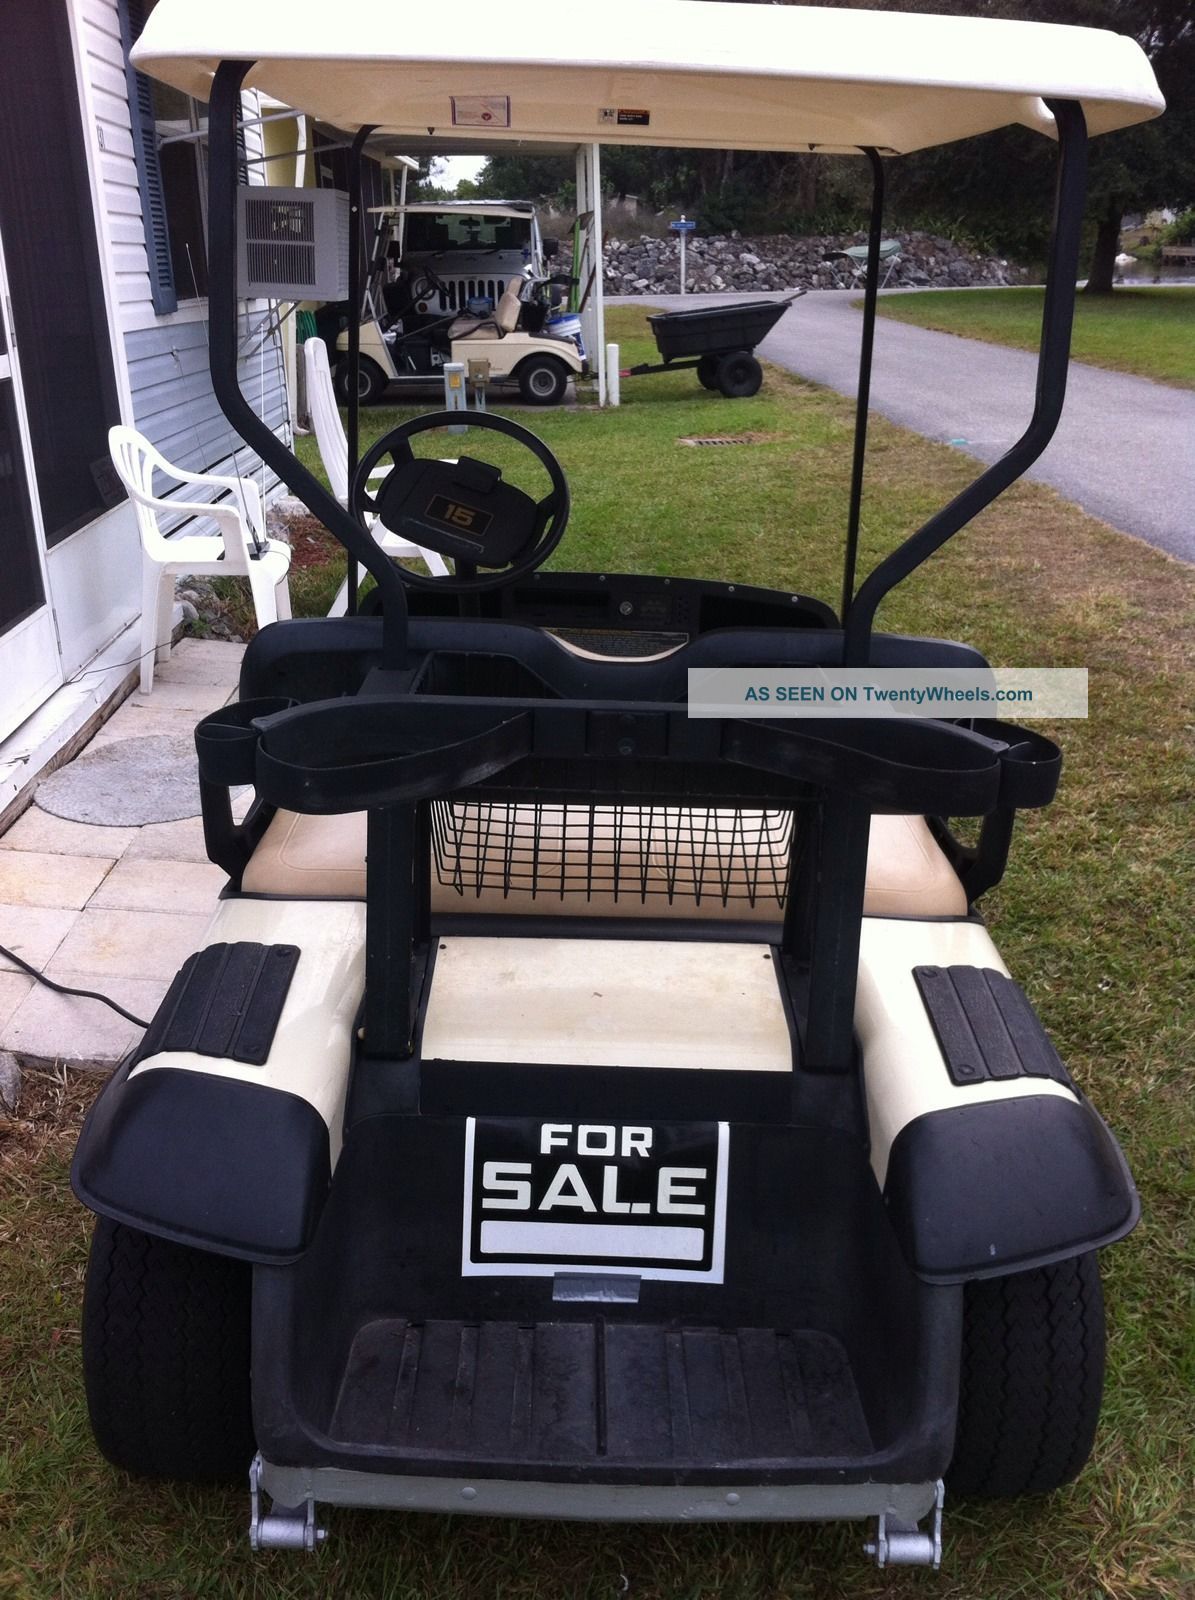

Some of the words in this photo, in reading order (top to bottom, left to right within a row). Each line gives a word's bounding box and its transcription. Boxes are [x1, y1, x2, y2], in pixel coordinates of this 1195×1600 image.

[445, 503, 476, 526] 15
[540, 1123, 653, 1158] FOR
[482, 1161, 707, 1216] SALE
